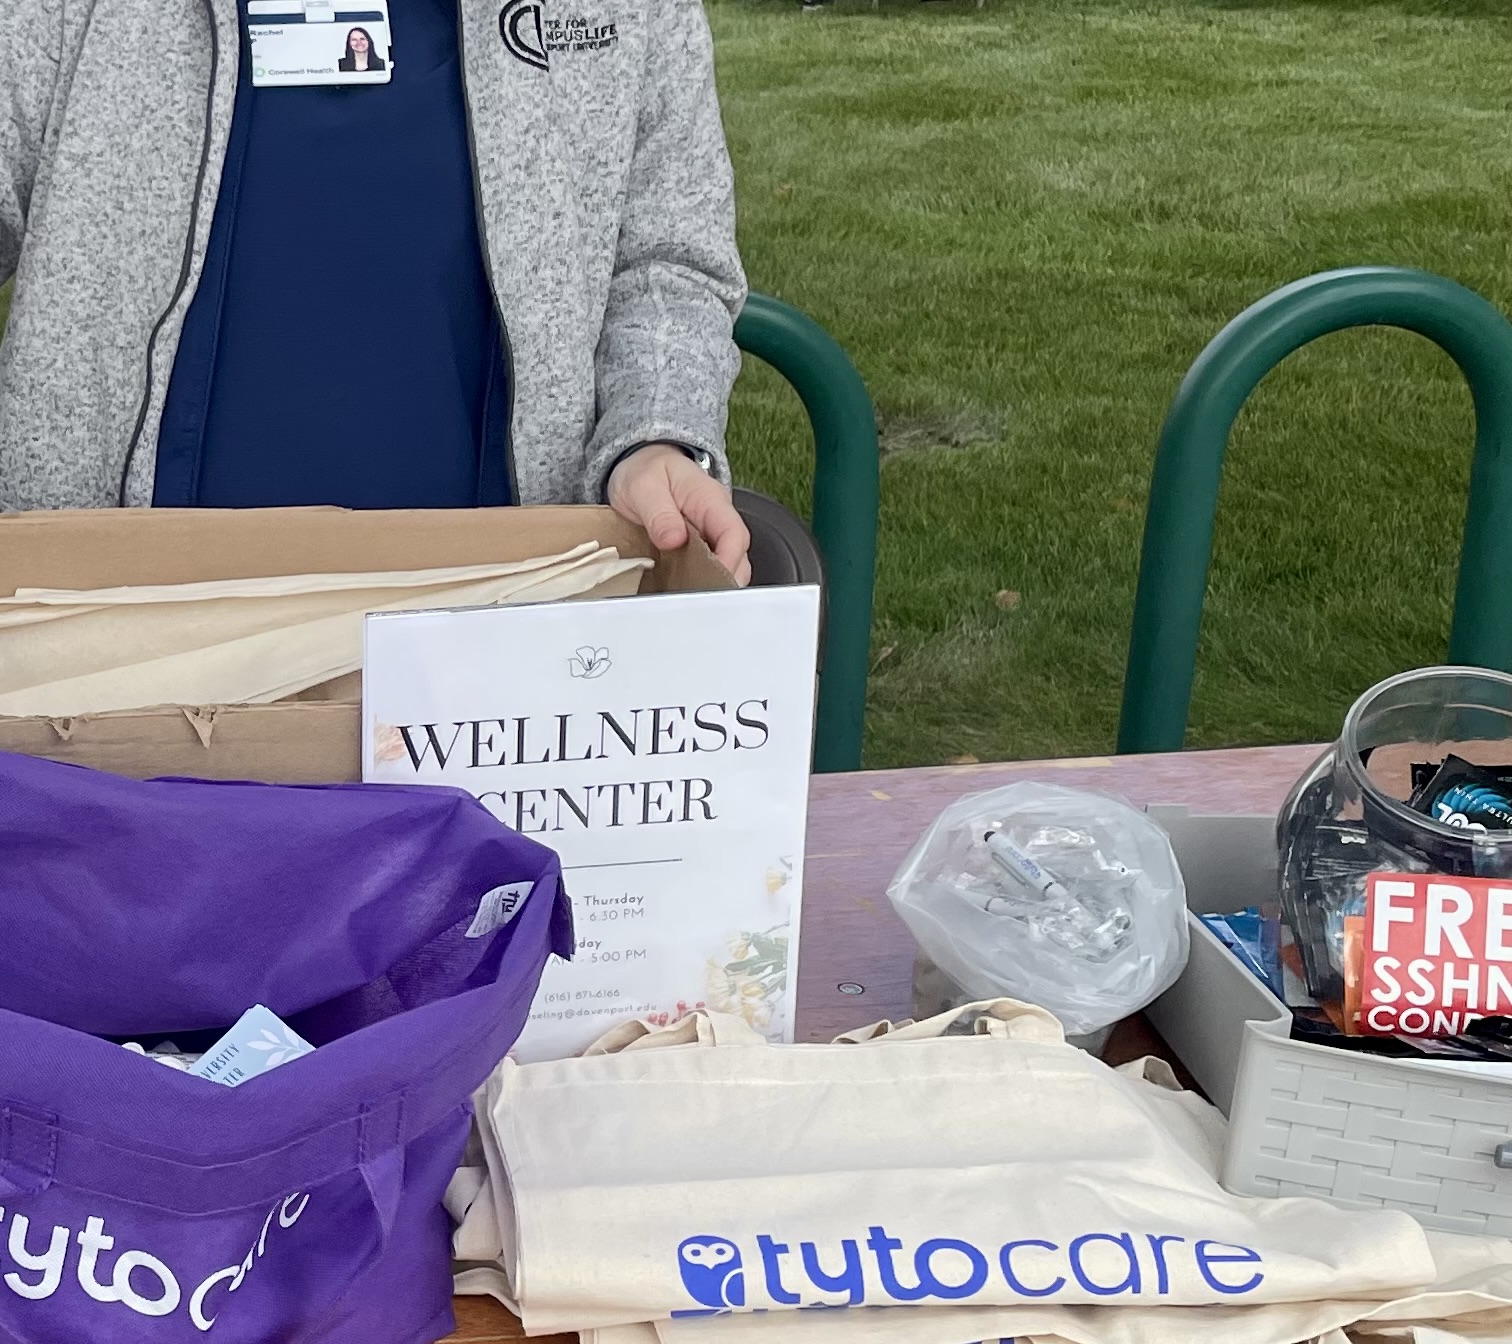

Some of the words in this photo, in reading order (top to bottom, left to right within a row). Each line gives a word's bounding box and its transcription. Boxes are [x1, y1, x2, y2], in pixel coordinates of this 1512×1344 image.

[397, 699, 770, 773] WELLNESS
[583, 892, 644, 906] Thursday
[623, 907, 644, 919] PM
[625, 949, 647, 961] PM
[755, 1225, 1264, 1307] tytocare
